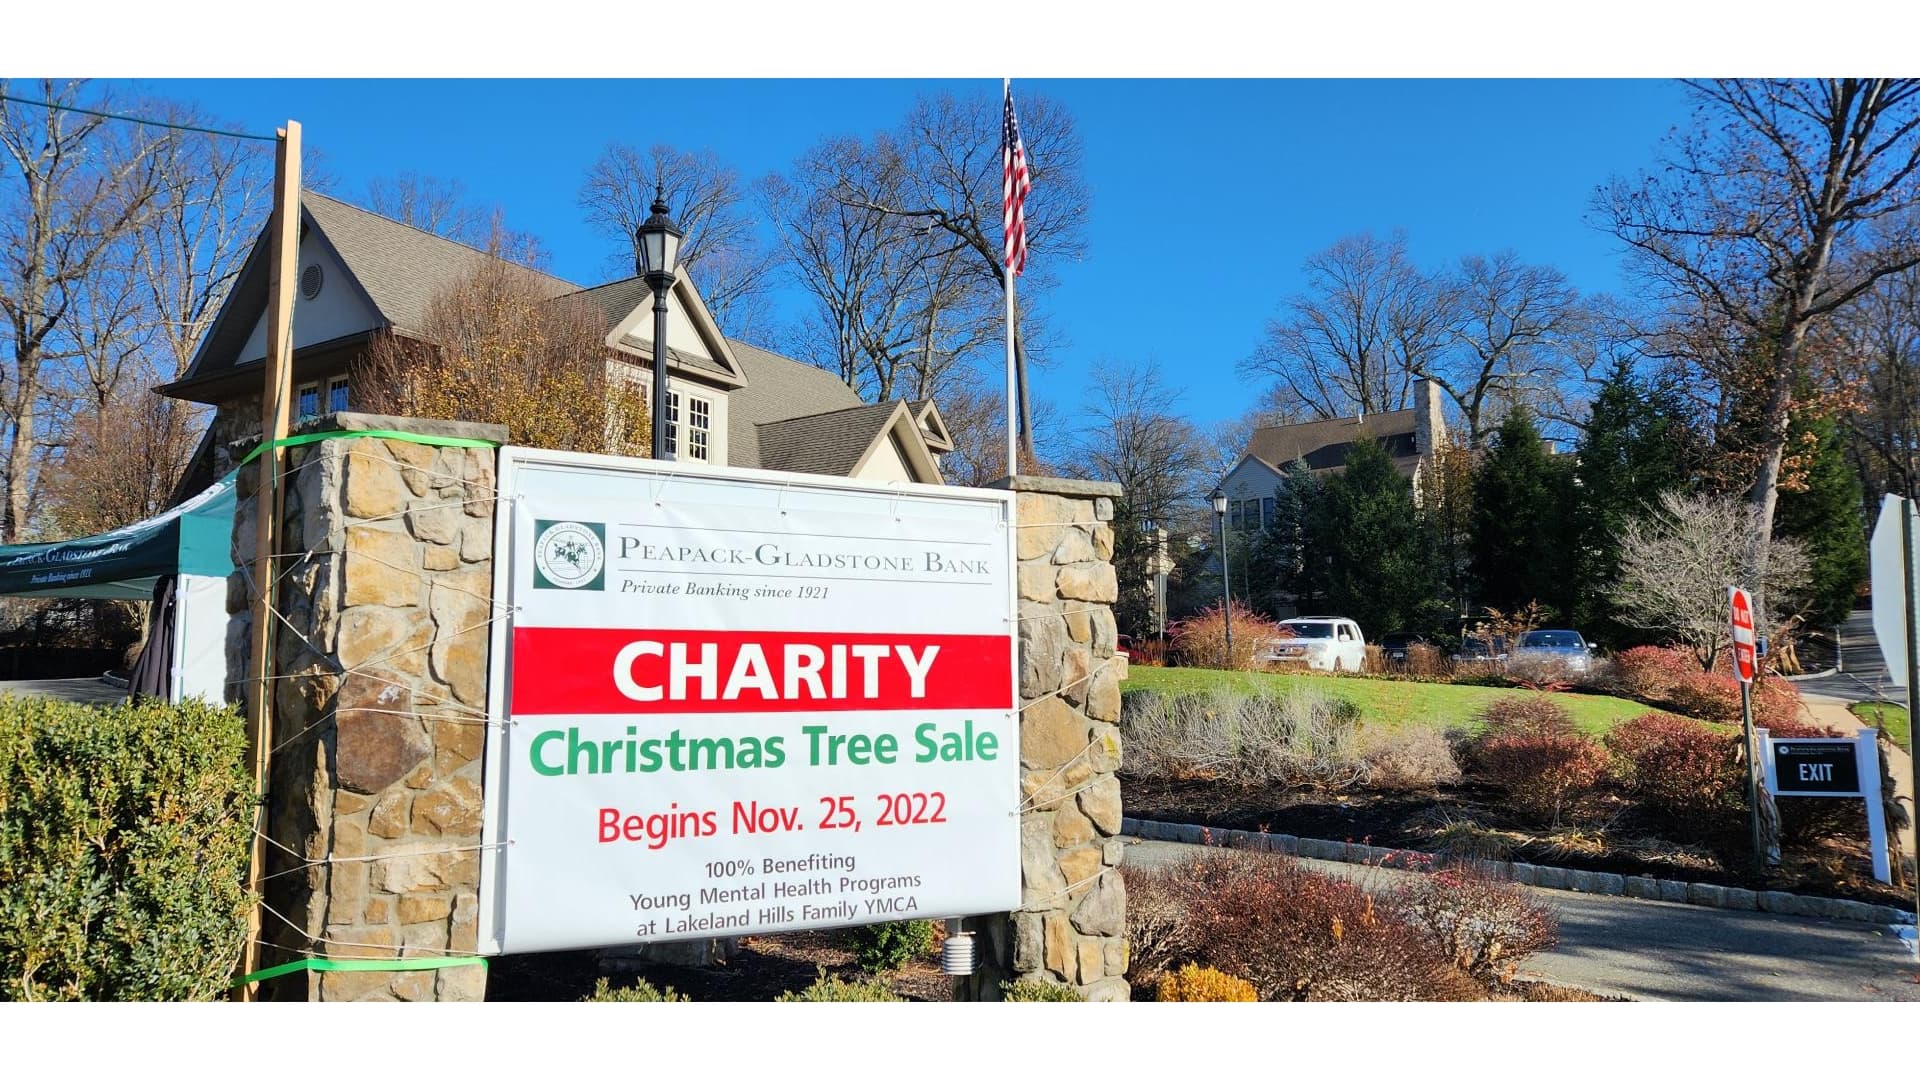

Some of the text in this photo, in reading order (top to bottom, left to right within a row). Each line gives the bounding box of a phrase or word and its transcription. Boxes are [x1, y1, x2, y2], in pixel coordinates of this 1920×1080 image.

[618, 535, 914, 573] PEAPACK-GLADSTONE
[923, 551, 990, 575] BANK
[621, 579, 830, 600] Private Banking since 1921
[613, 640, 941, 702] CHARITY
[529, 720, 999, 777] Christmas Tree Sale
[1799, 763, 1833, 782] EXIT
[599, 792, 947, 850] Begins Nov. 25, 2022
[705, 853, 856, 879] 100% Benefiting
[630, 872, 922, 911] Young Mental Health Programs
[637, 896, 918, 936] at Lakeland Hills Family YMCA
